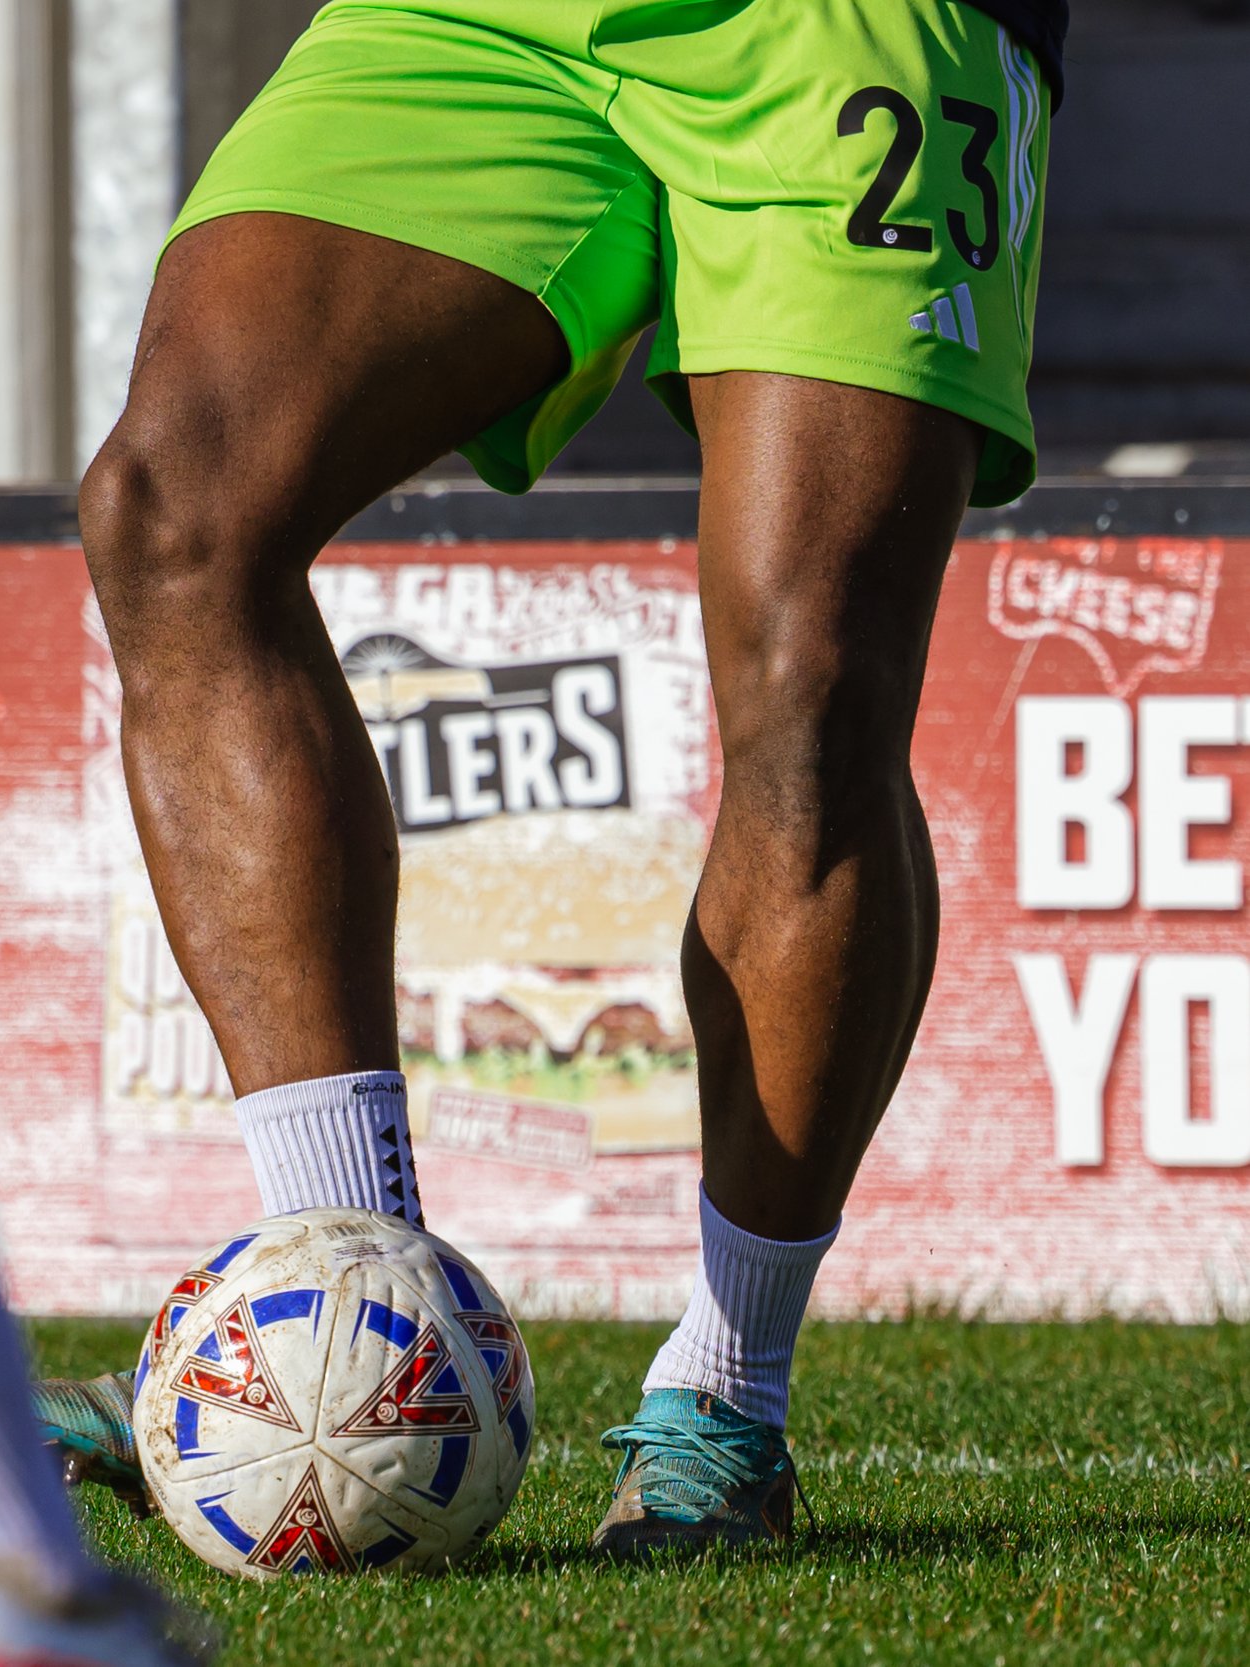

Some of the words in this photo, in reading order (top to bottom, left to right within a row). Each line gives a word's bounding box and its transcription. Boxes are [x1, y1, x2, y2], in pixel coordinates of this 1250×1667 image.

[837, 85, 999, 271] 23
[366, 663, 623, 825] LERS
[1016, 695, 1250, 911] BE
[1012, 953, 1250, 1168] YO
